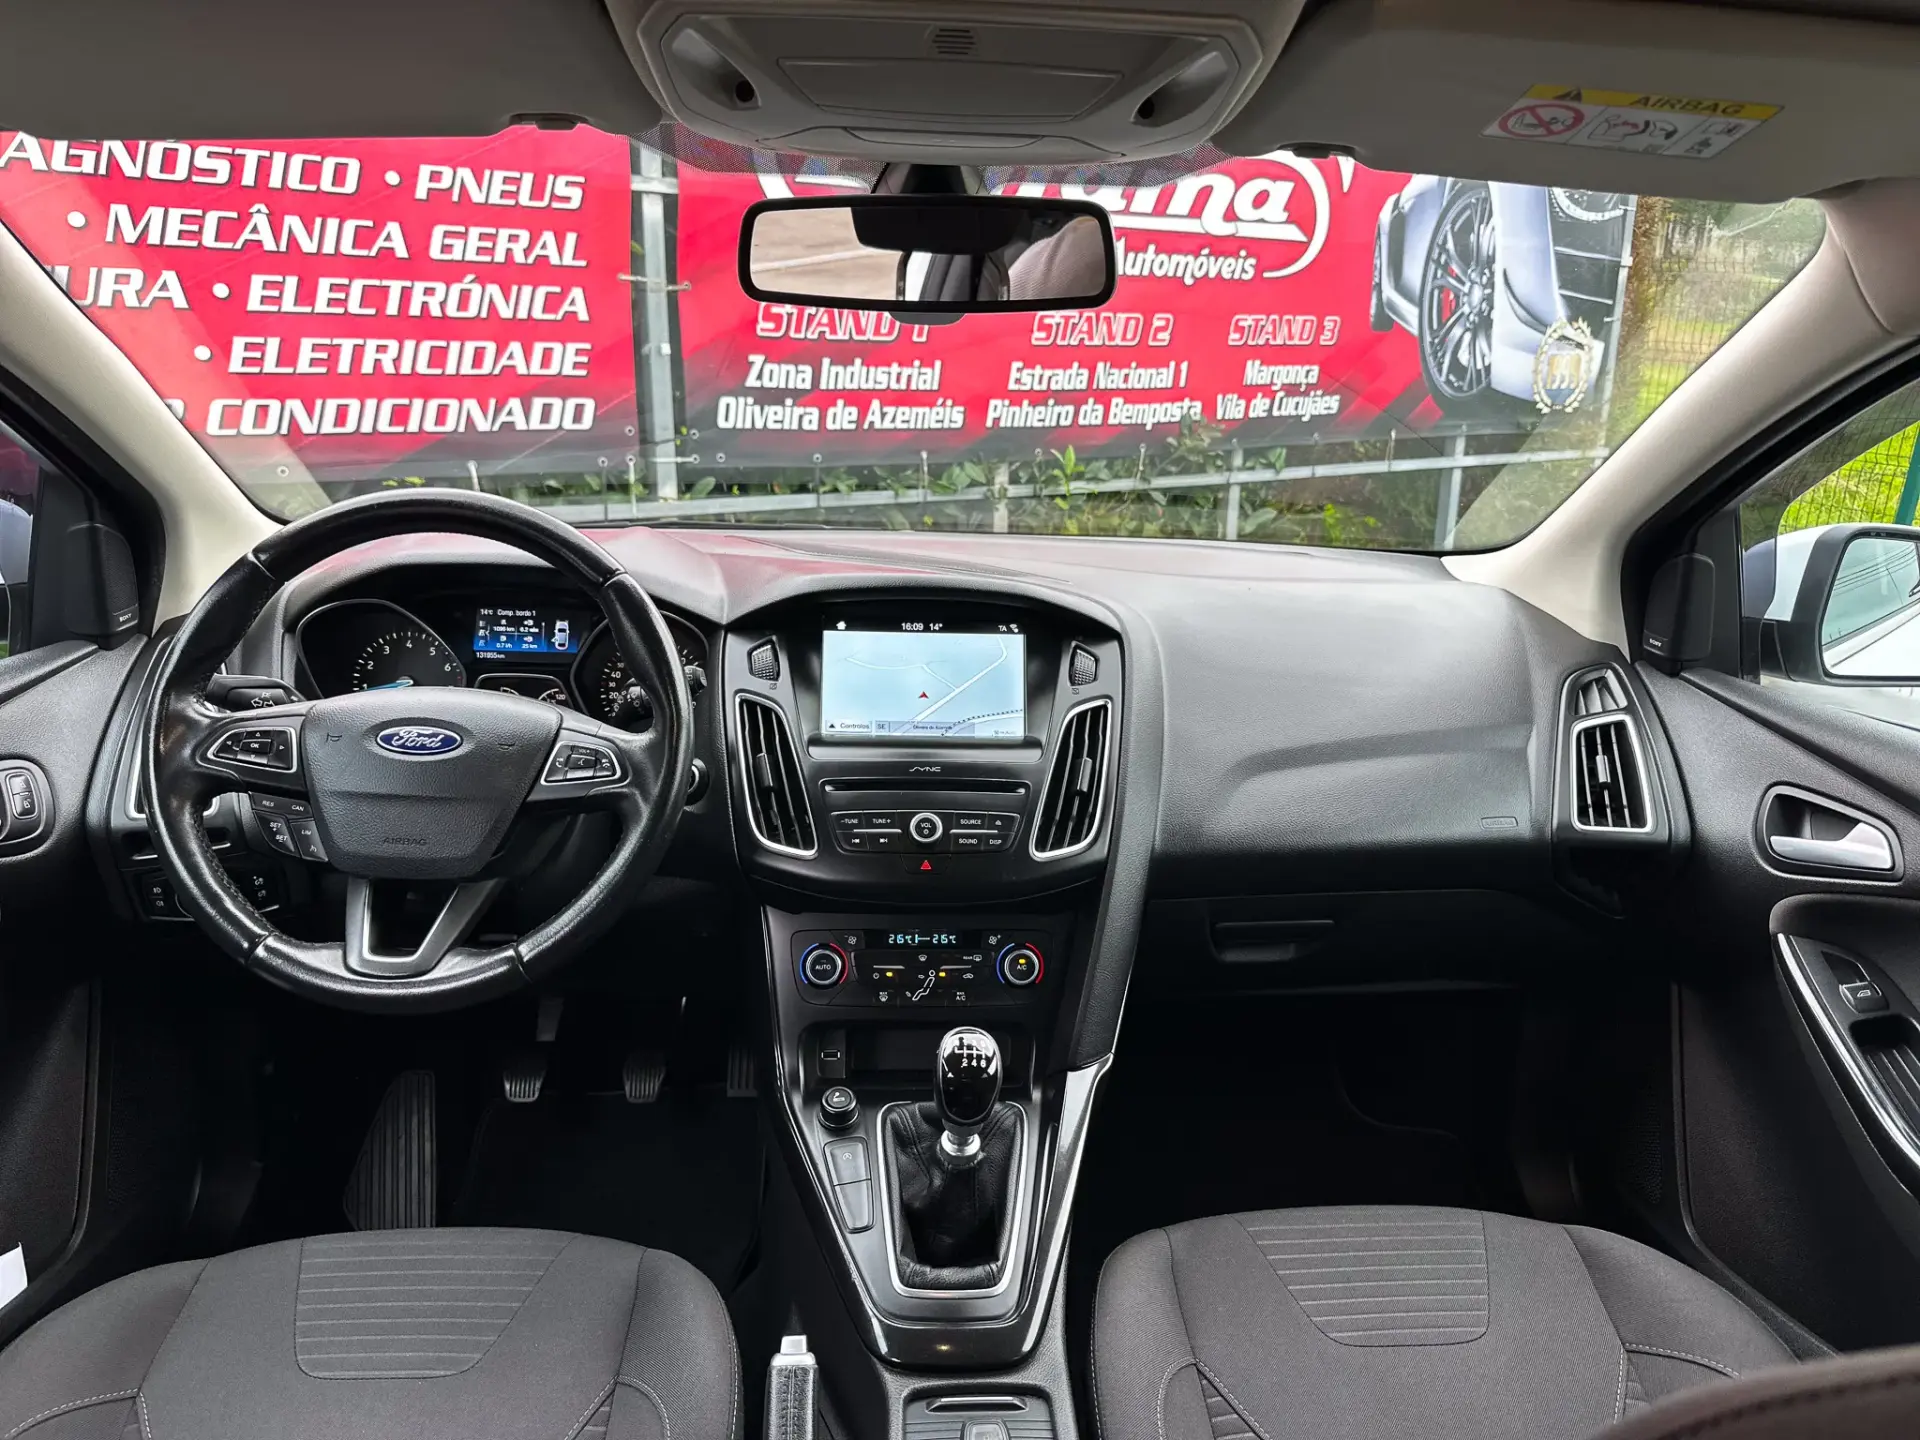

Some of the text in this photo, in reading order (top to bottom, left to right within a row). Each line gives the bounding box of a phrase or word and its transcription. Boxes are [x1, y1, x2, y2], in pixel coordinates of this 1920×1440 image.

[1628, 96, 1746, 115] AIRBAG
[415, 164, 586, 210] PNEUS
[105, 203, 588, 267] MECÂNICA GERAL
[247, 274, 590, 322] ELECTRÓNICA
[756, 301, 901, 342] STAND
[1031, 311, 1174, 346] STAND 2
[1228, 314, 1341, 346] STAND 3
[227, 336, 592, 377] ELETRICIDADE
[744, 354, 943, 392] Zona Industrial
[1007, 360, 1189, 392] Estrada Nacional 1
[1243, 360, 1320, 392] Margonça
[205, 397, 596, 436] CONDICIONADO
[717, 396, 965, 431] Oliveira de Azeméis
[985, 397, 1203, 431] Pinheiro da Bemposta
[1216, 389, 1340, 422] Vila de Cucujães
[901, 622, 924, 632] 16:09
[383, 645, 390, 655] 3
[406, 639, 413, 649] 4
[429, 646, 436, 656] 5
[367, 660, 374, 670] 2
[444, 663, 452, 672] 6
[611, 671, 621, 679] 40
[391, 728, 444, 748] Ford
[269, 821, 282, 829] SET
[960, 818, 982, 826] SOURCE
[815, 963, 832, 971] AUTO
[971, 1058, 978, 1067] 4
